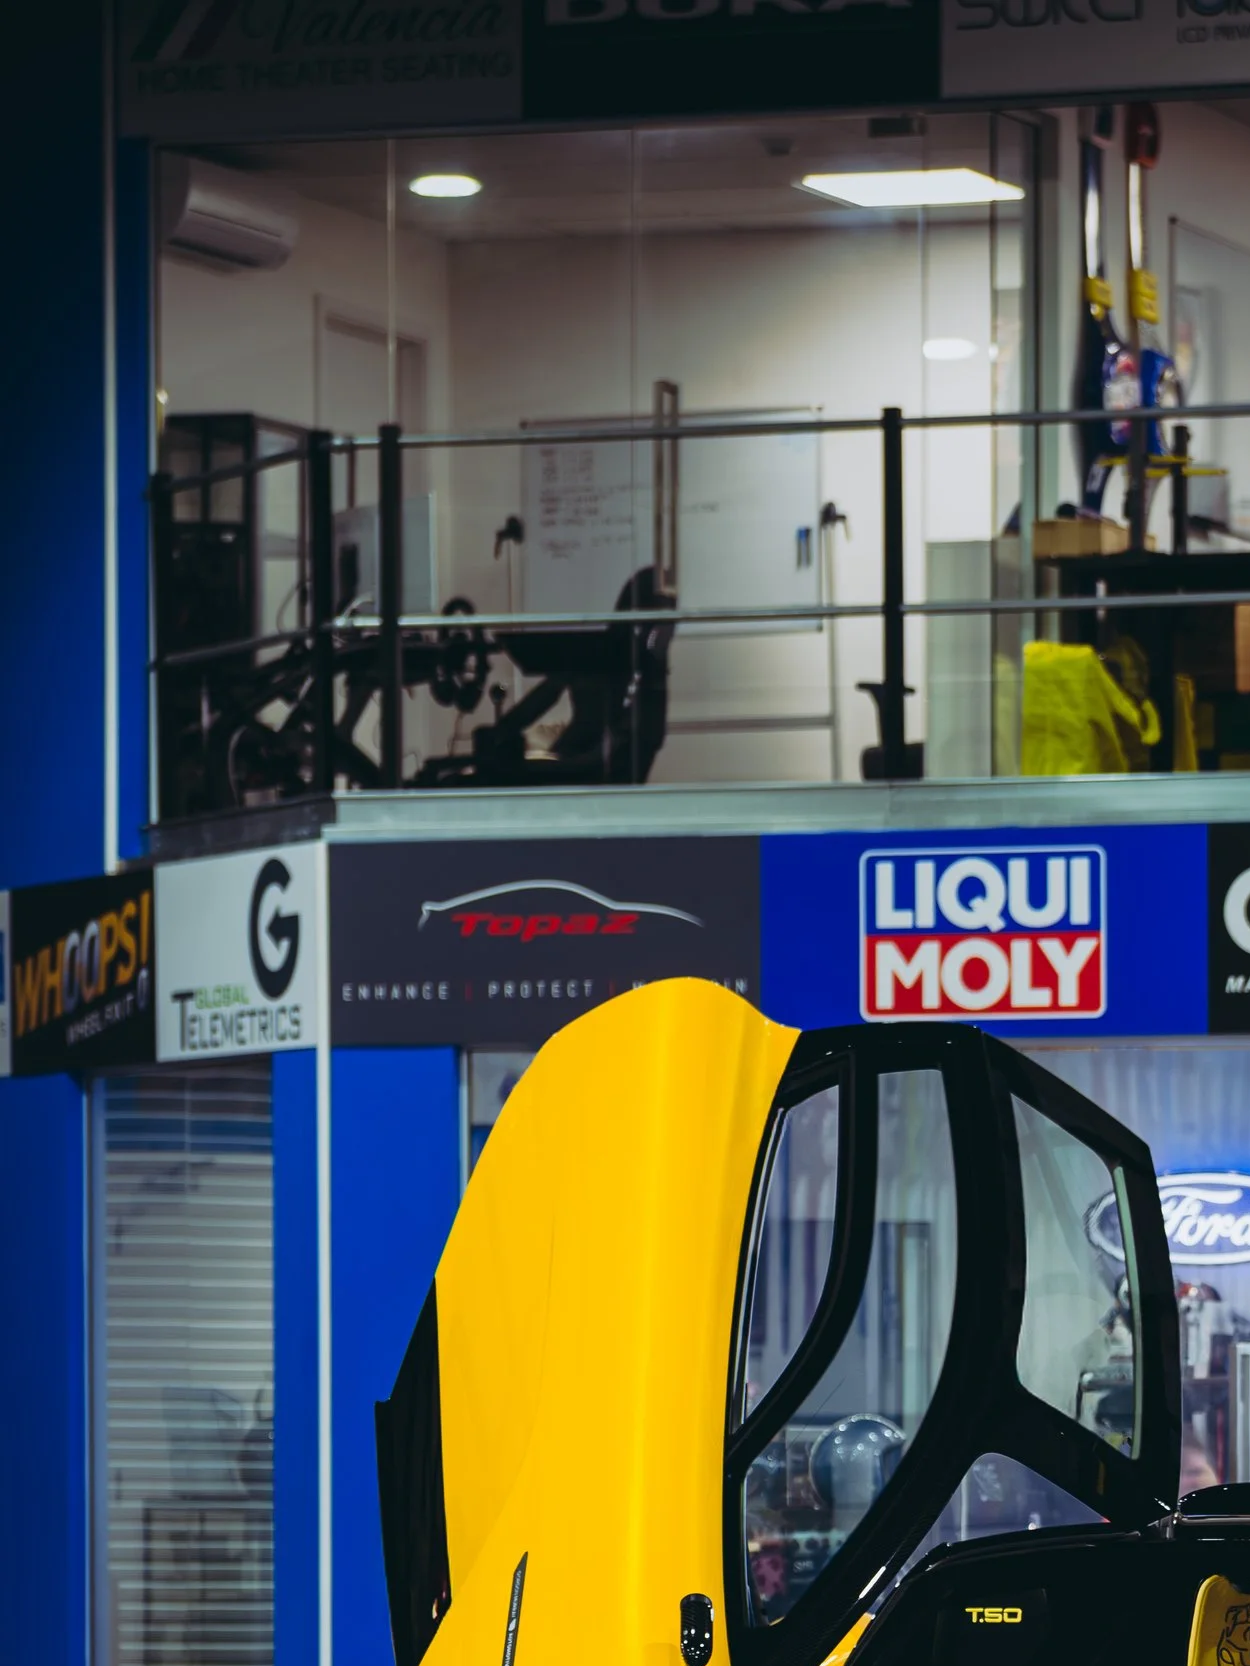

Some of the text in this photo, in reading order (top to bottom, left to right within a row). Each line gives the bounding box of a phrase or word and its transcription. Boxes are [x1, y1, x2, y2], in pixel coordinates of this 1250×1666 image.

[136, 51, 512, 93] HOME THEATER SEATING
[875, 856, 1091, 934] LIQUI
[14, 889, 150, 1037] WHOOPS!
[875, 937, 1099, 1010] MOLY
[195, 984, 249, 1010] GLOBAL
[342, 979, 595, 1001] ENHANCE PROTECT
[171, 988, 302, 1052] TELEMETRICS
[965, 1606, 1022, 1624] T.50
